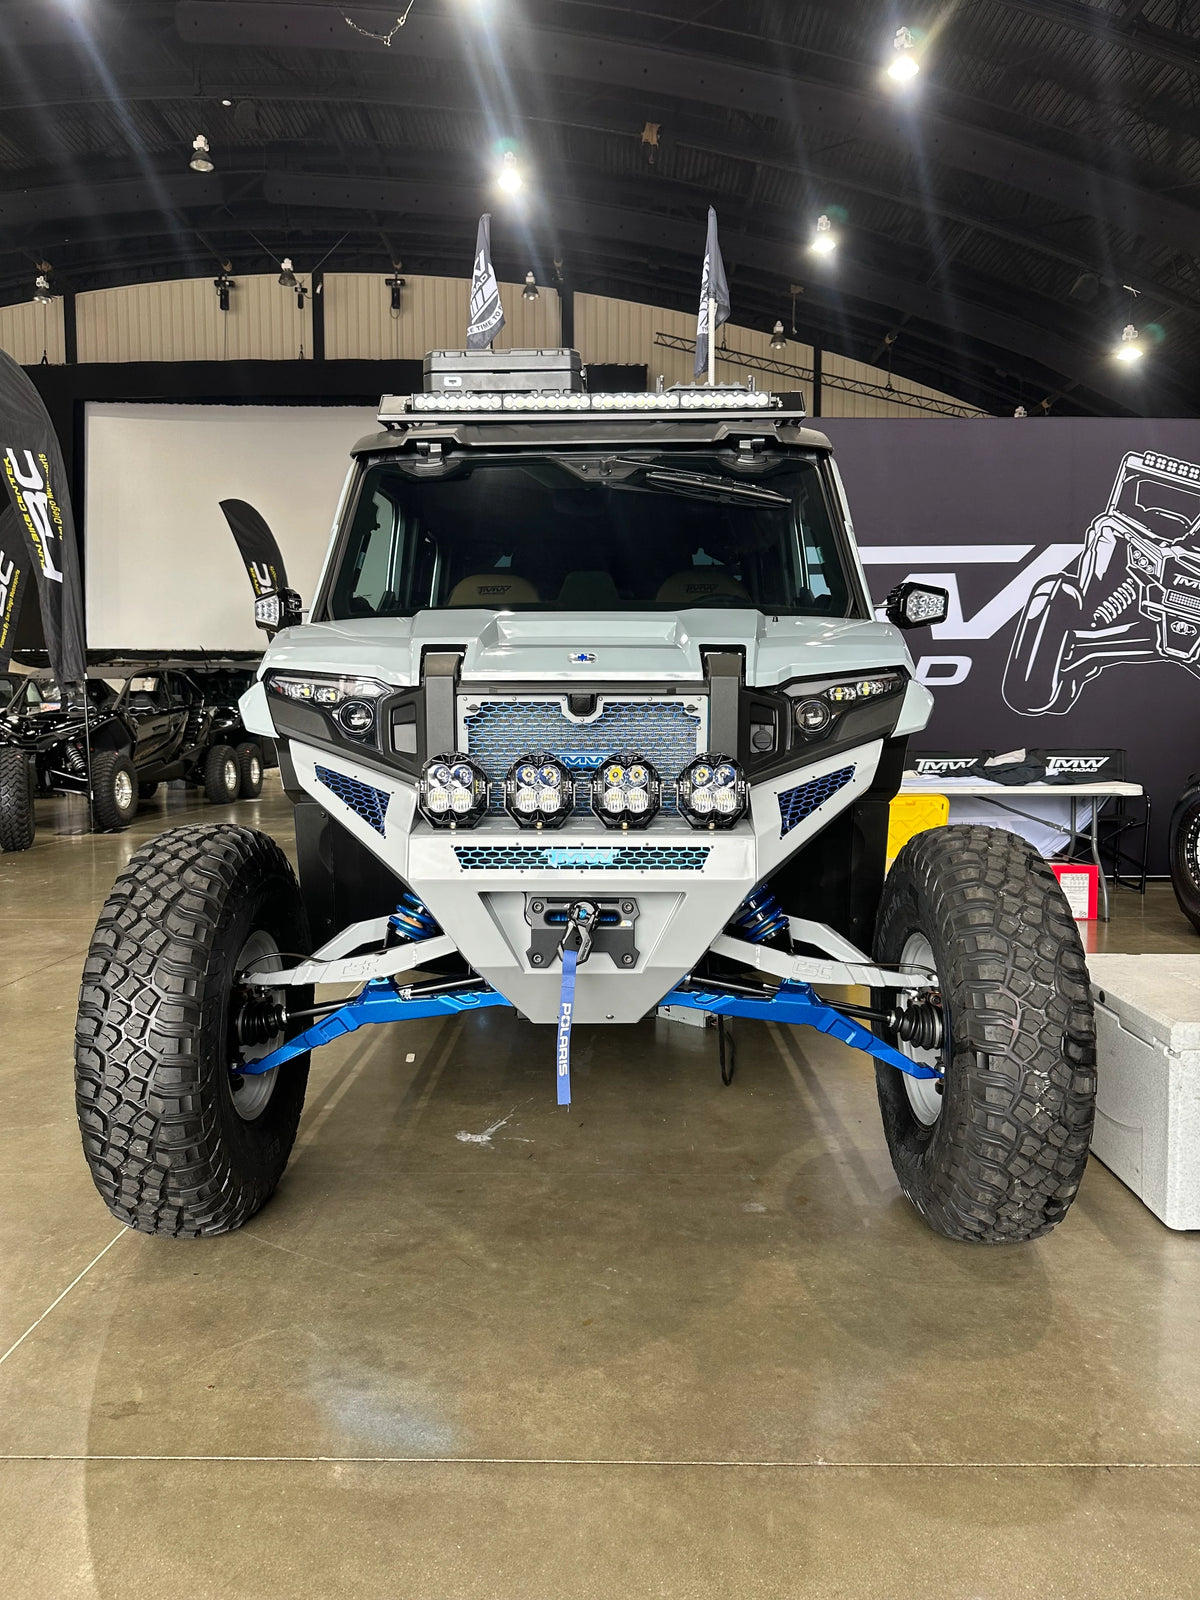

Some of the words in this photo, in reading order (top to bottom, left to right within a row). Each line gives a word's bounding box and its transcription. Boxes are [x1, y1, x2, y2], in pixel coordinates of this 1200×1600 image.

[476, 320, 493, 331] TIME
[3, 456, 27, 512] CENTER
[49, 500, 62, 524] Diego
[23, 513, 40, 542] BIKE
[1046, 756, 1110, 769] TMW
[541, 849, 620, 868] TMW
[559, 1002, 572, 1077] POLARIS
